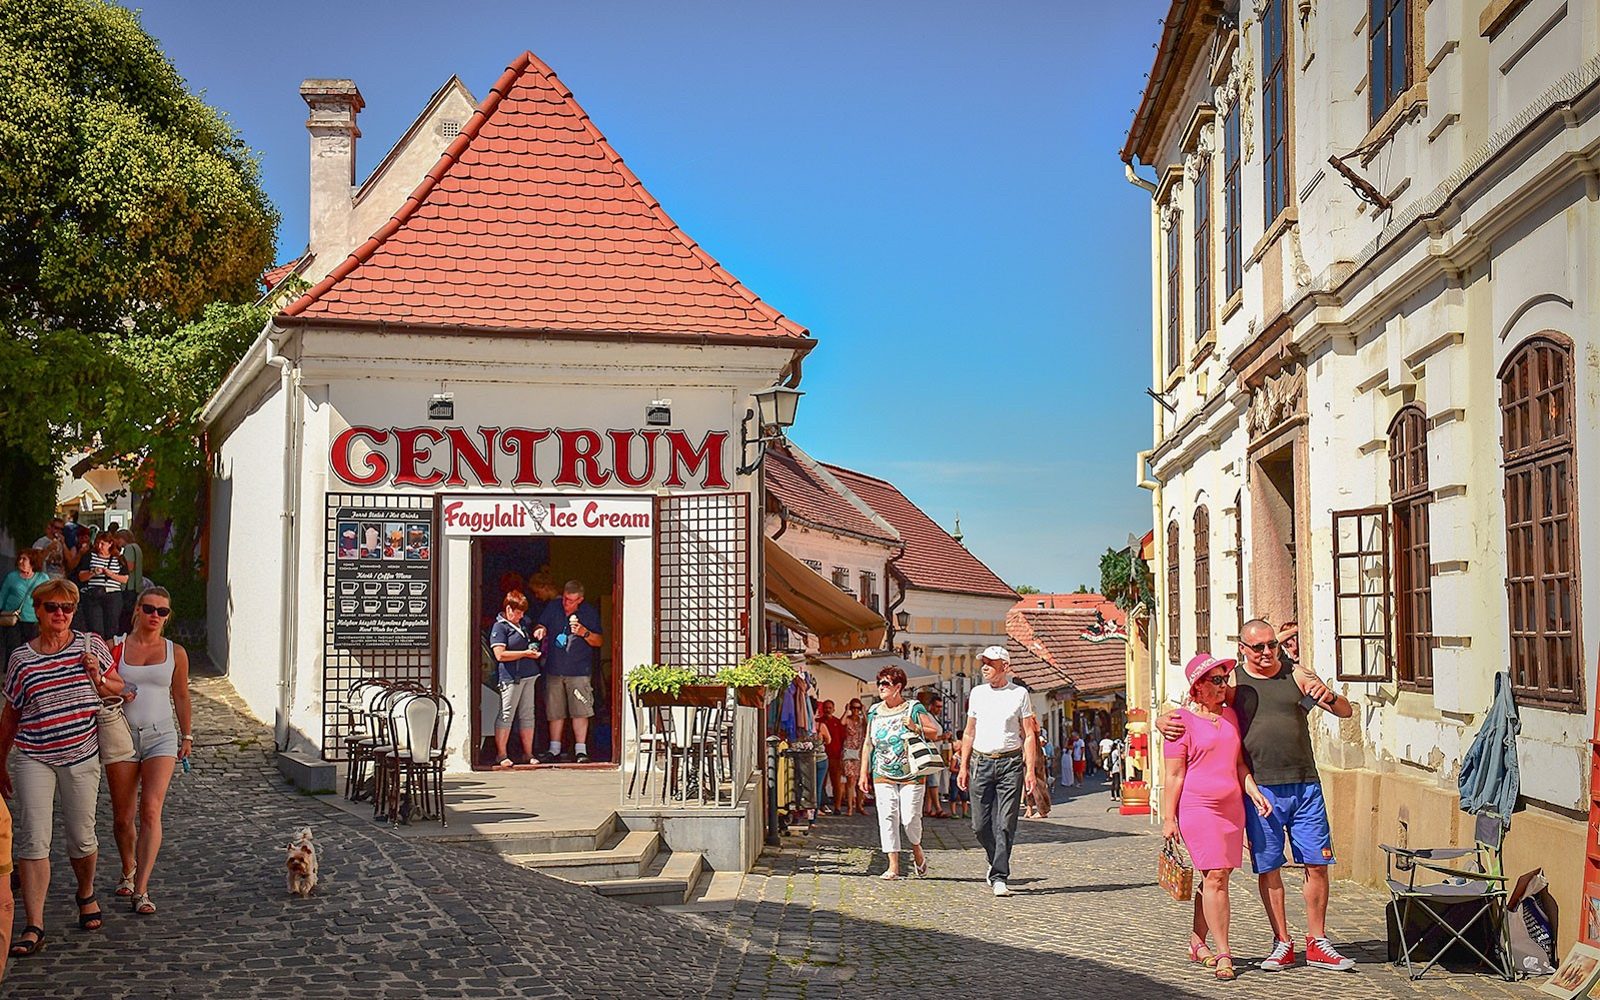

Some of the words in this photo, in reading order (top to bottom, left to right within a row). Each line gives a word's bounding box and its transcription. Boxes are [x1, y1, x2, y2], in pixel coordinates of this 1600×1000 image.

[328, 425, 730, 488] CENTRUM
[444, 501, 527, 532] Fagylalt
[550, 503, 577, 528] Ice
[583, 501, 650, 528] Cream
